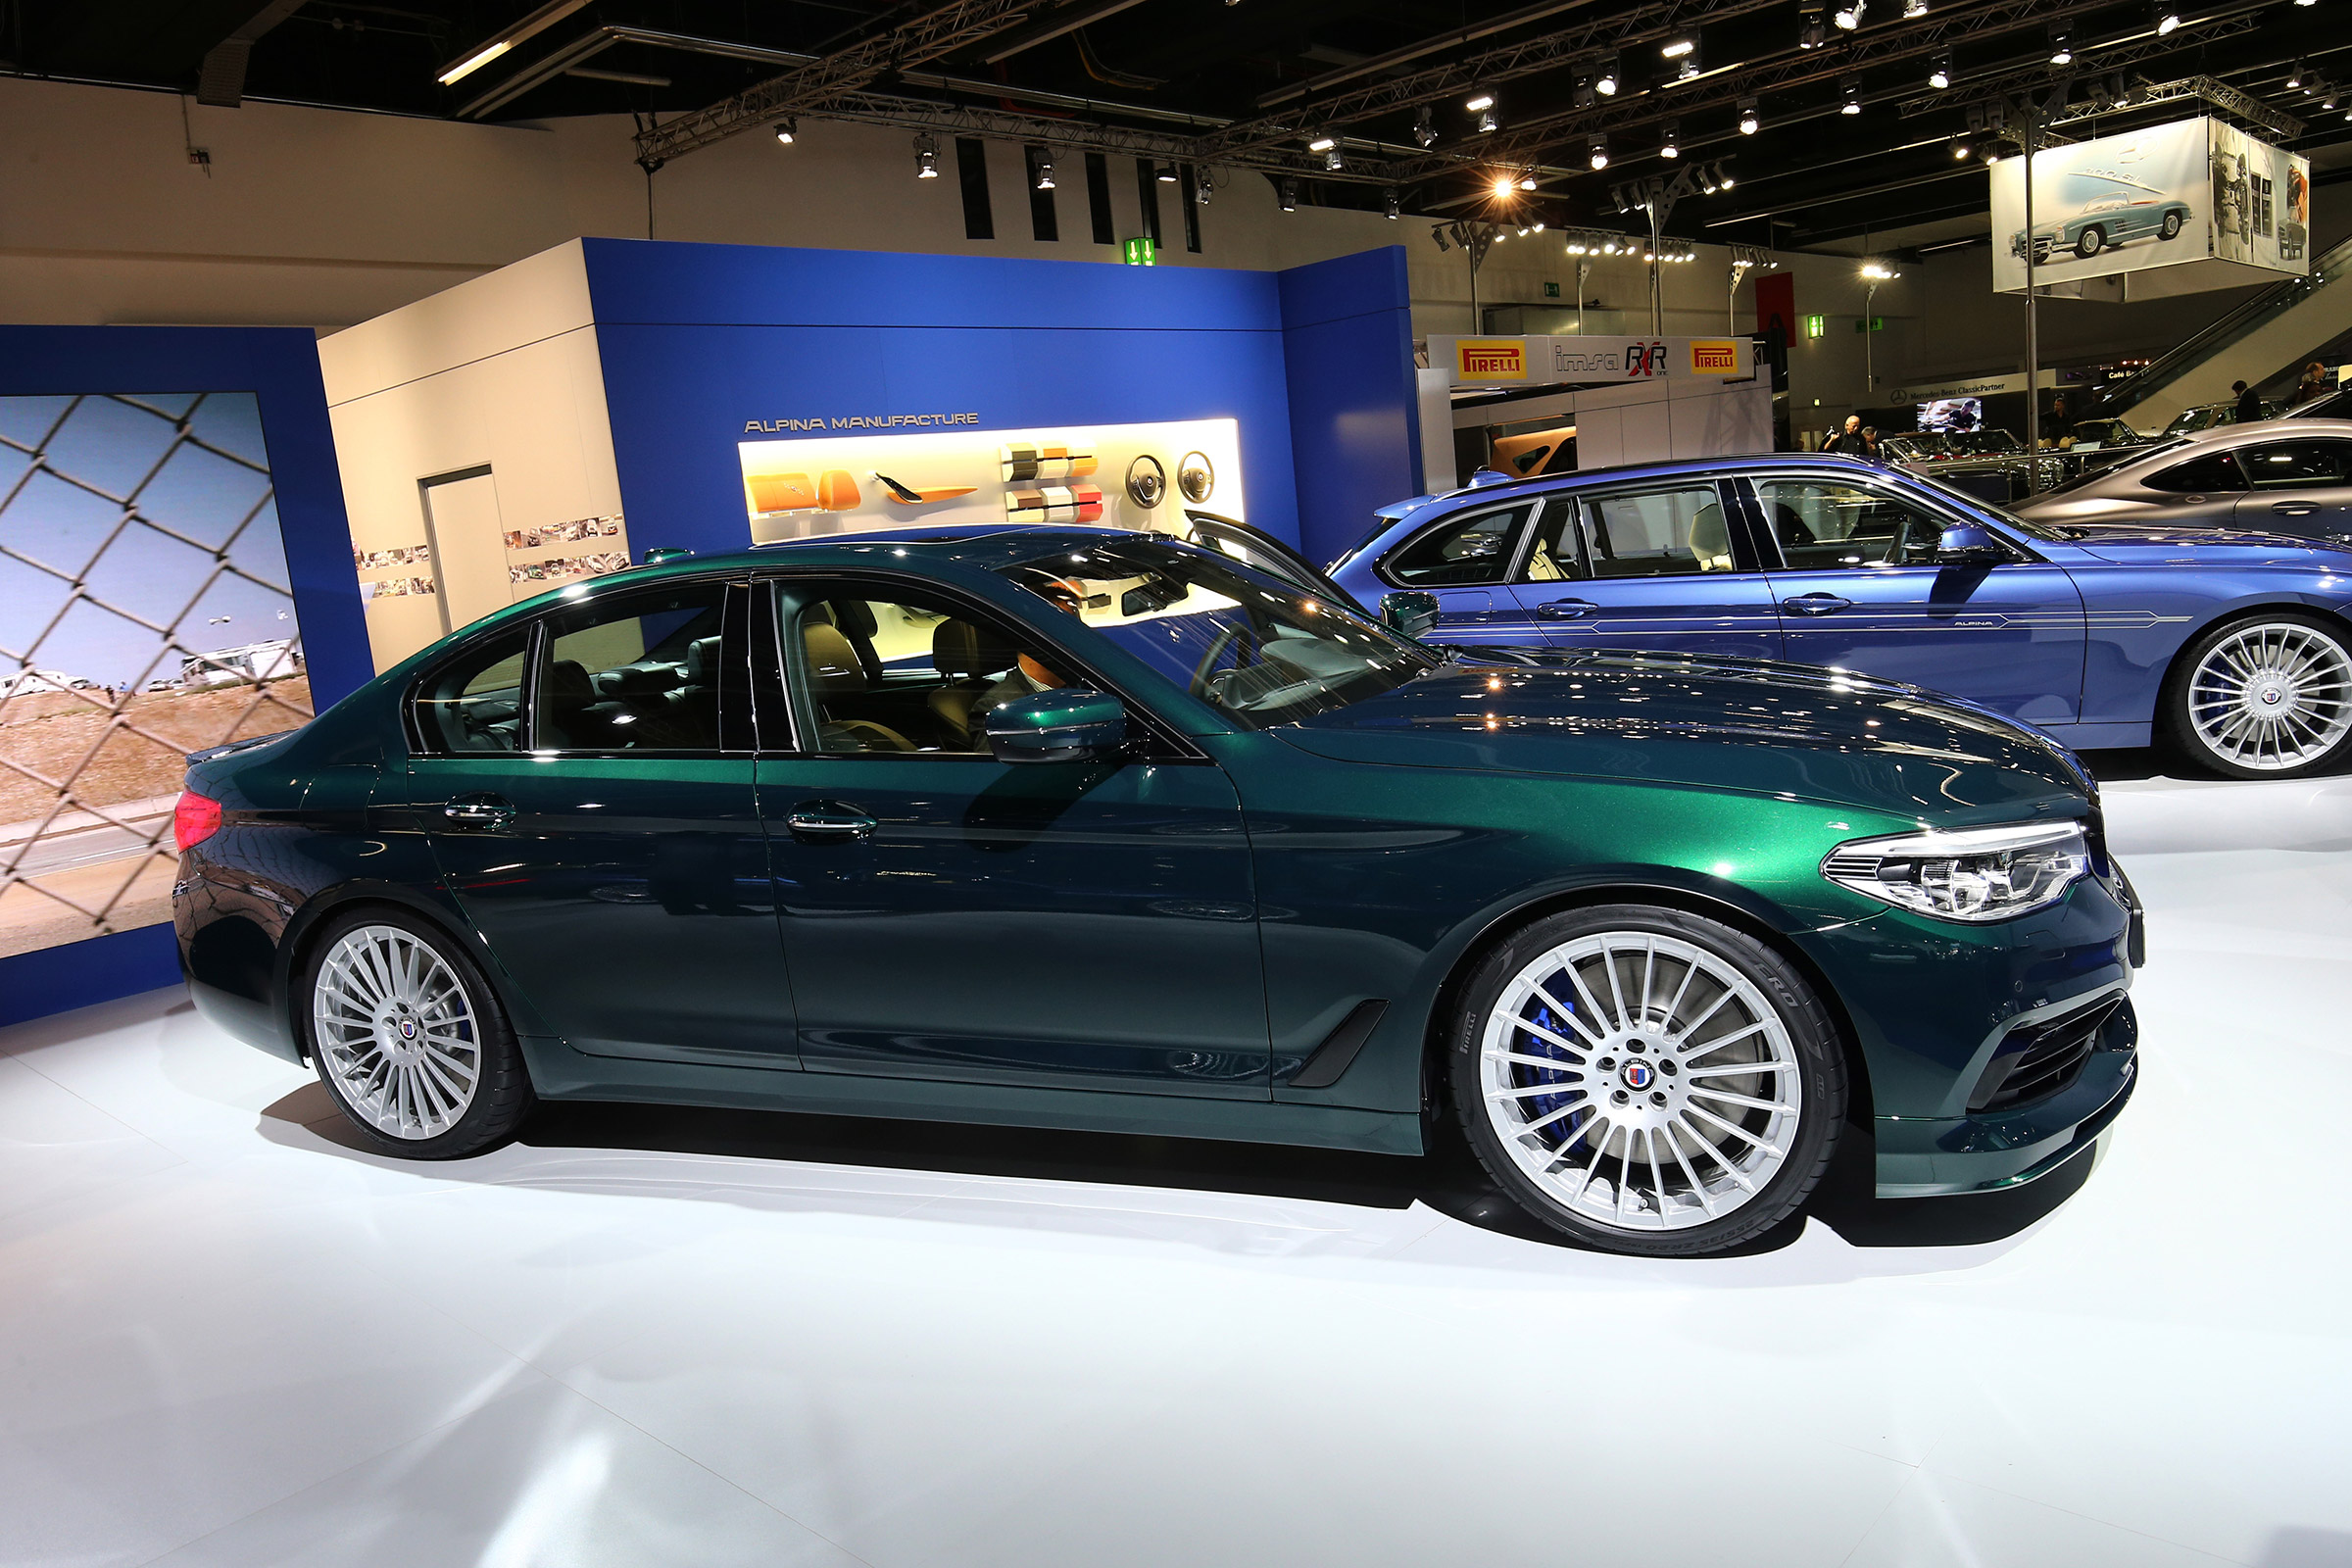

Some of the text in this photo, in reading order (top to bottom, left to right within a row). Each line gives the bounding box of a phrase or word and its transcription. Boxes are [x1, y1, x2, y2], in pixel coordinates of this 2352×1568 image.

[1462, 348, 1520, 371] PIRELLI
[1555, 345, 1619, 371] imsa
[1693, 347, 1734, 368] PIRELLI
[1958, 383, 2005, 395] ClassicPartner
[743, 412, 980, 434] ALPINA MANUFACTURE
[1459, 1010, 1477, 1054] PIRELLI
[1620, 1058, 1655, 1078] ALPINA
